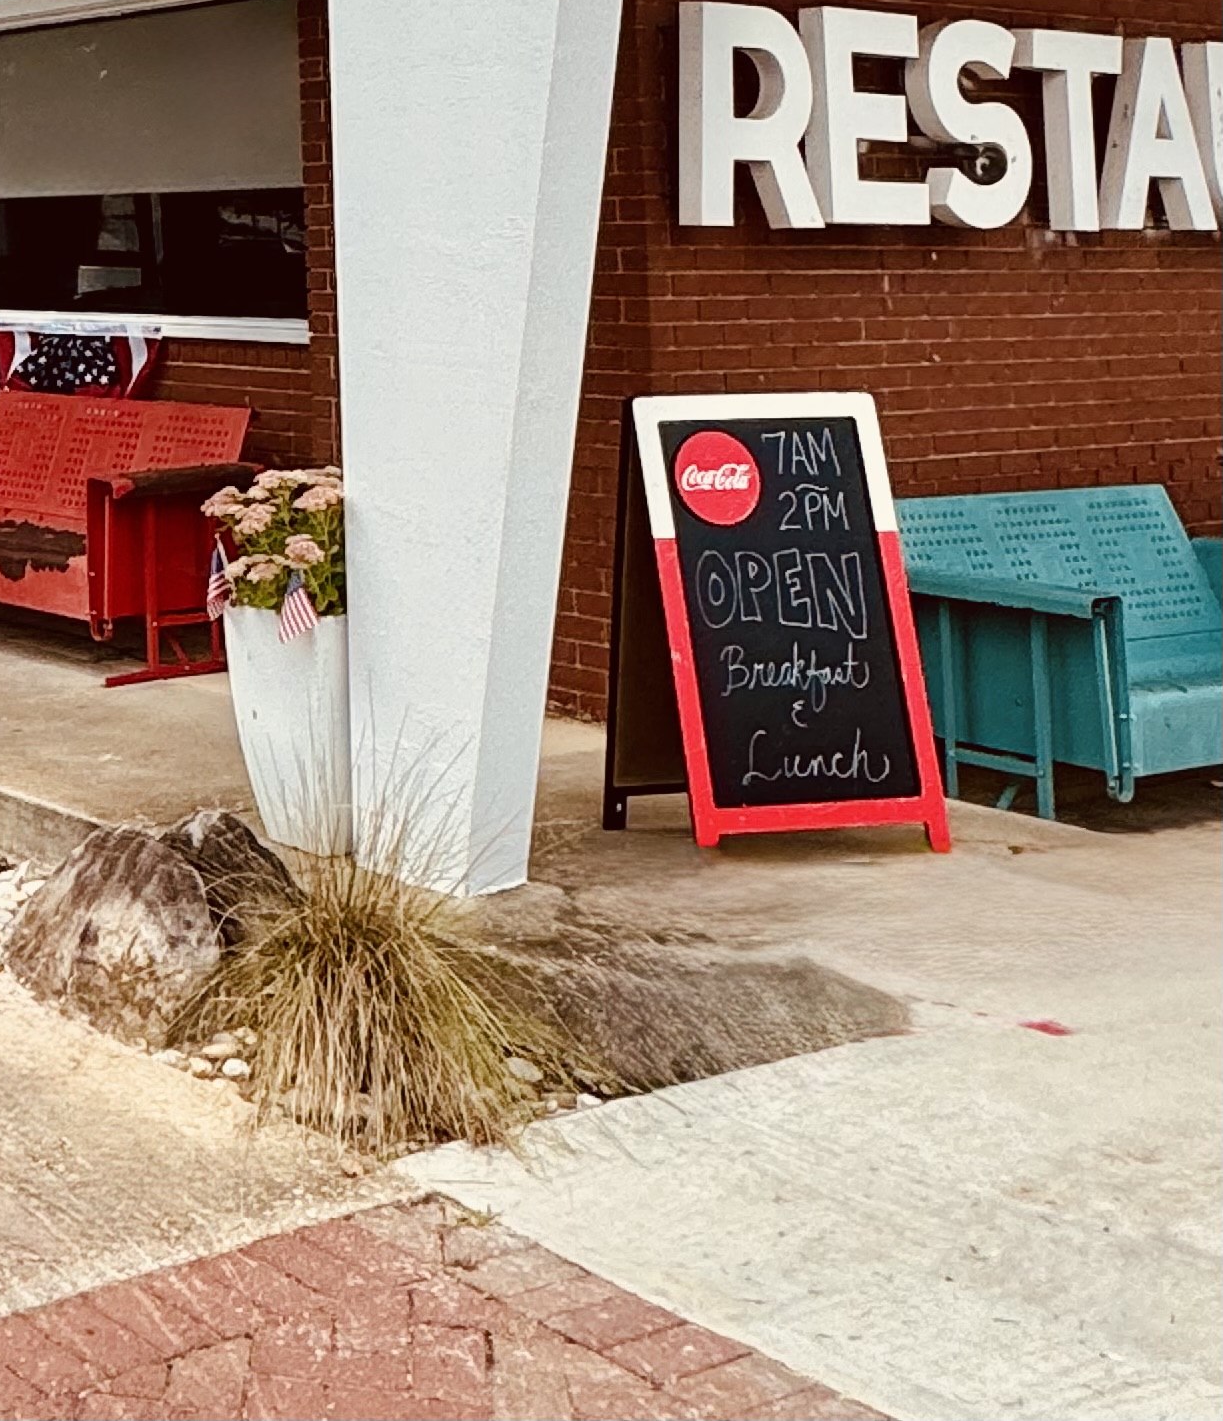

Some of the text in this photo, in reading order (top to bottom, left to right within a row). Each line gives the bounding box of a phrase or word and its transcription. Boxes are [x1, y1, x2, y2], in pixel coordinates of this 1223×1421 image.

[679, 1, 1223, 232] RESTA
[760, 426, 843, 478] 7AM
[777, 489, 851, 532] 2PM
[695, 547, 868, 640] OPEN
[719, 641, 871, 712] Breakfast
[741, 727, 891, 786] Lunch
